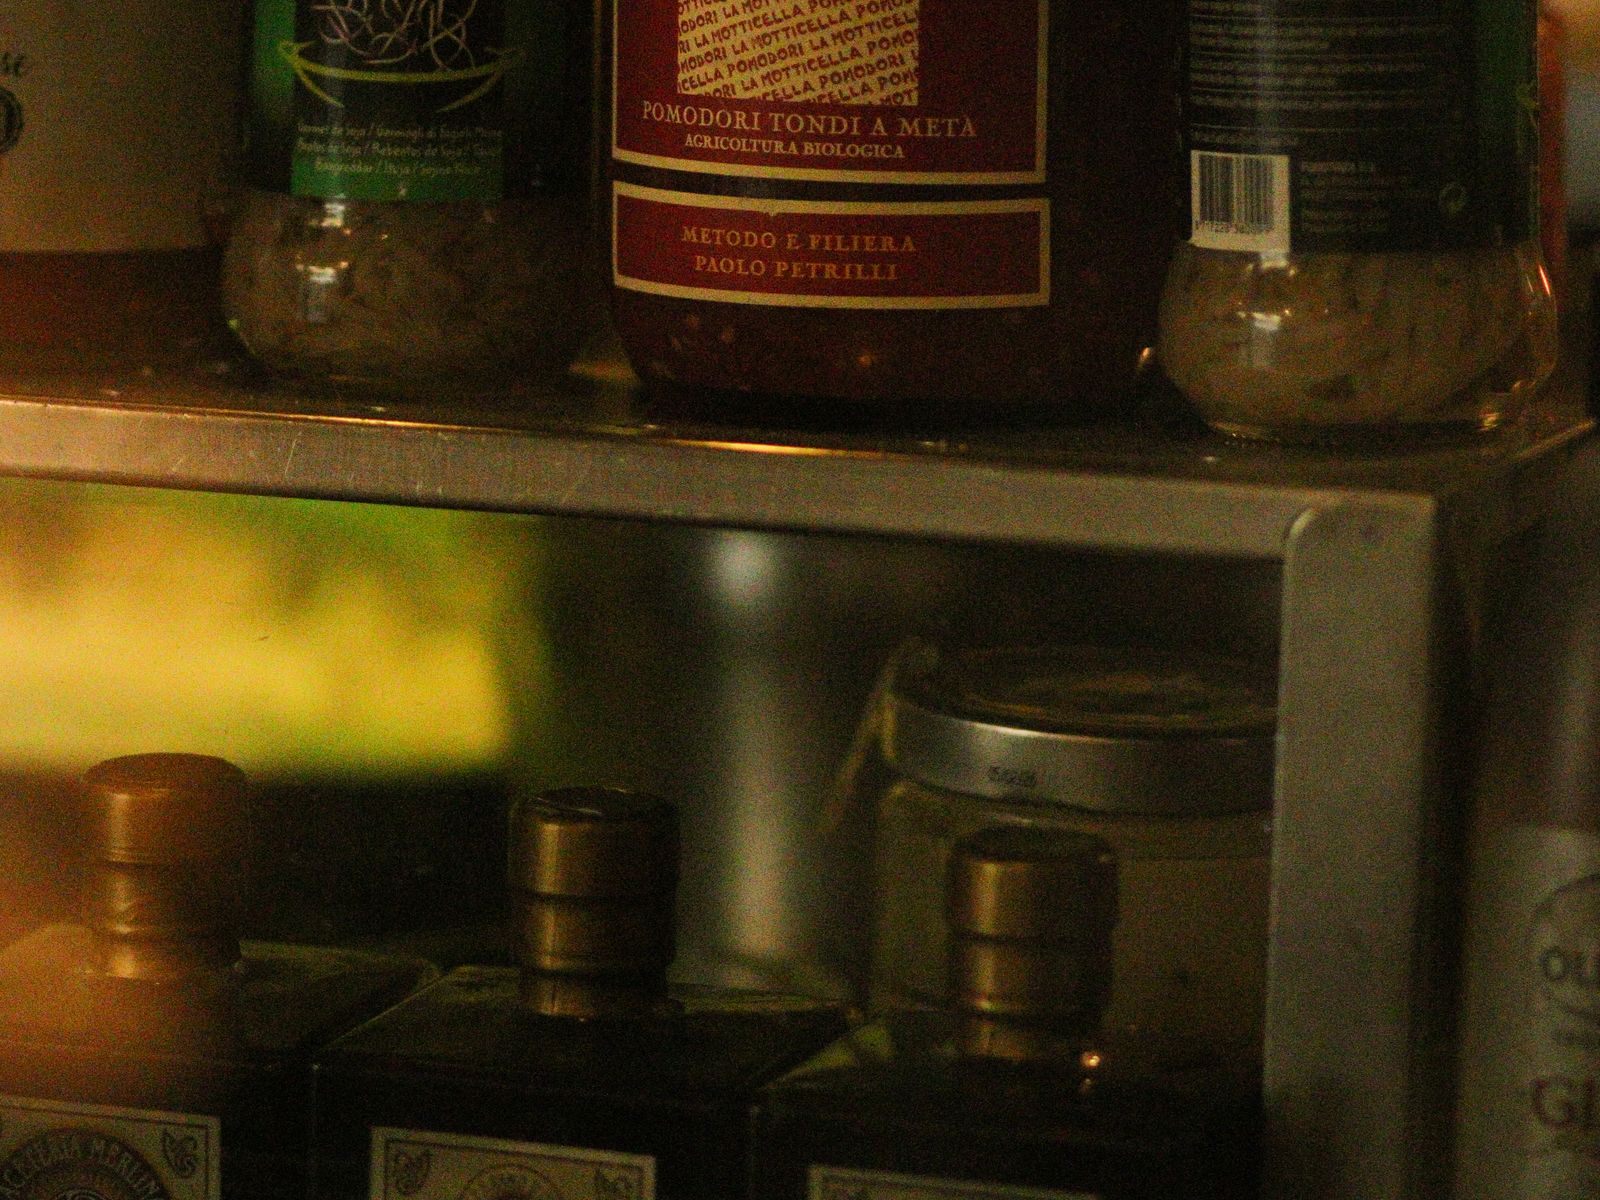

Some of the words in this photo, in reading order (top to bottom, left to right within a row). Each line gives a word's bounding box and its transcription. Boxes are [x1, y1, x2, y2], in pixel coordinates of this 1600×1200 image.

[679, 10, 719, 37] ODORI
[723, 4, 740, 19] LA
[694, 33, 710, 48] LA
[711, 4, 805, 43] MOTTICELLA
[731, 40, 749, 55] LA
[751, 10, 852, 50] MOTTICELLA
[727, 43, 805, 78] POMODORI
[809, 36, 829, 51] LA
[741, 78, 758, 91] LA
[761, 46, 863, 87] MOTTICELLA
[819, 53, 905, 89] POMODORI
[642, 99, 761, 131] POMODORI
[770, 111, 860, 137] TONDI
[872, 118, 890, 137] A
[685, 133, 799, 155] AGRICOLTURA
[802, 141, 906, 160] BIOLOGICA
[682, 225, 777, 249] METODO
[786, 232, 801, 250] E
[809, 234, 917, 253] FILIERA
[694, 254, 766, 276] PAOLO
[775, 260, 898, 281] PETRILLI
